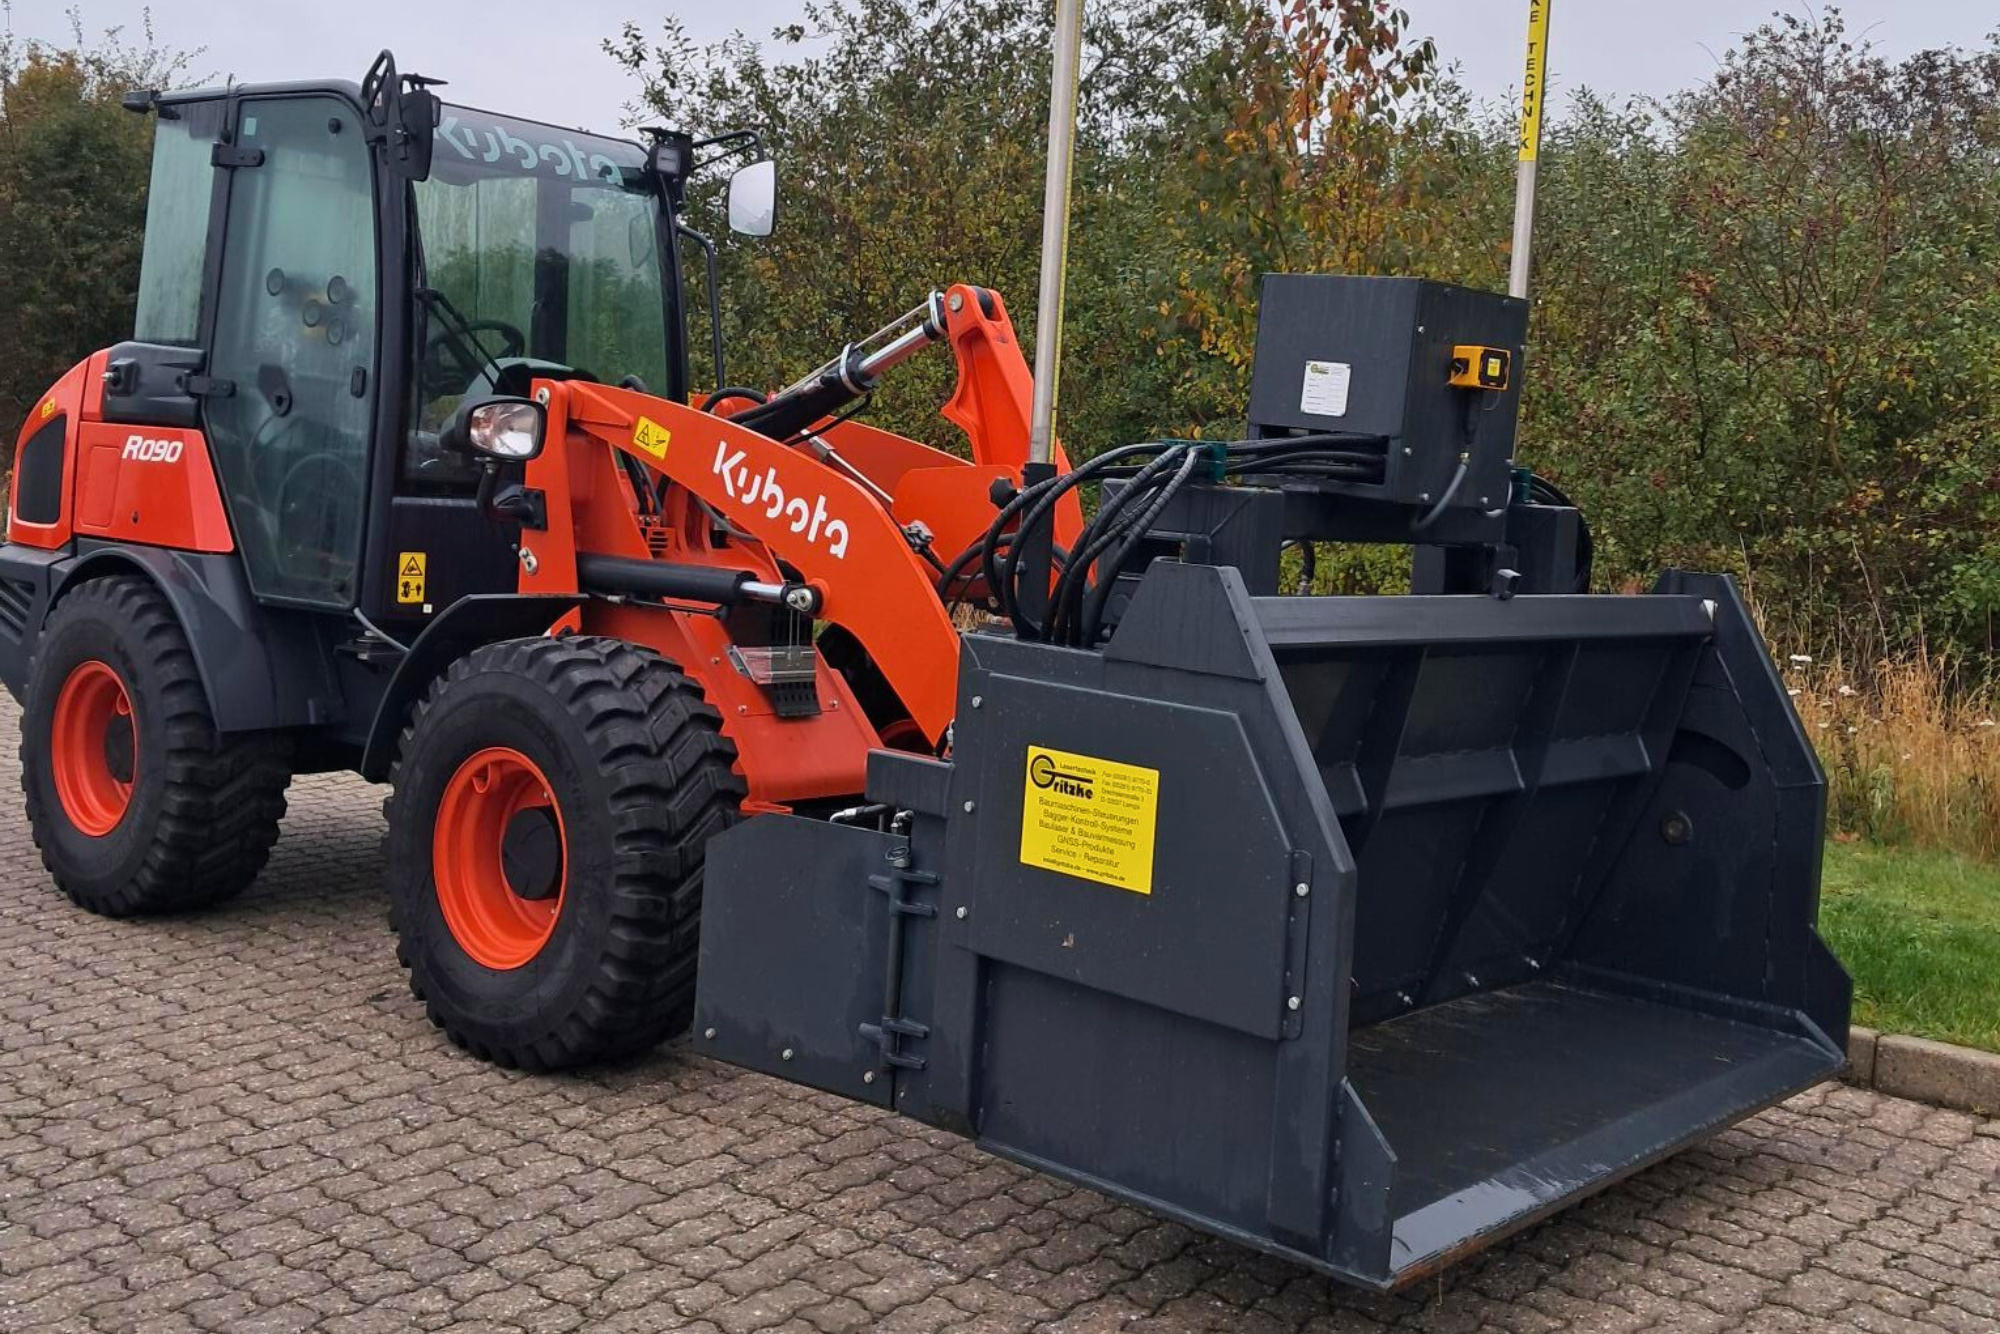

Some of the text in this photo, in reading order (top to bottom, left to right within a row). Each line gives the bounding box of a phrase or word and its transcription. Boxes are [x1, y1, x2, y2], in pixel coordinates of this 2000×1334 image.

[1520, 42, 1538, 150] TECHNIK
[433, 116, 625, 187] Kubota
[712, 440, 849, 560] Kubota
[1030, 754, 1094, 800] Gritzke
[1057, 834, 1115, 856] GNSS-Produkte
[1070, 826, 1077, 836] &
[1050, 844, 1078, 859] Service
[1083, 852, 1120, 869] Reparatur
